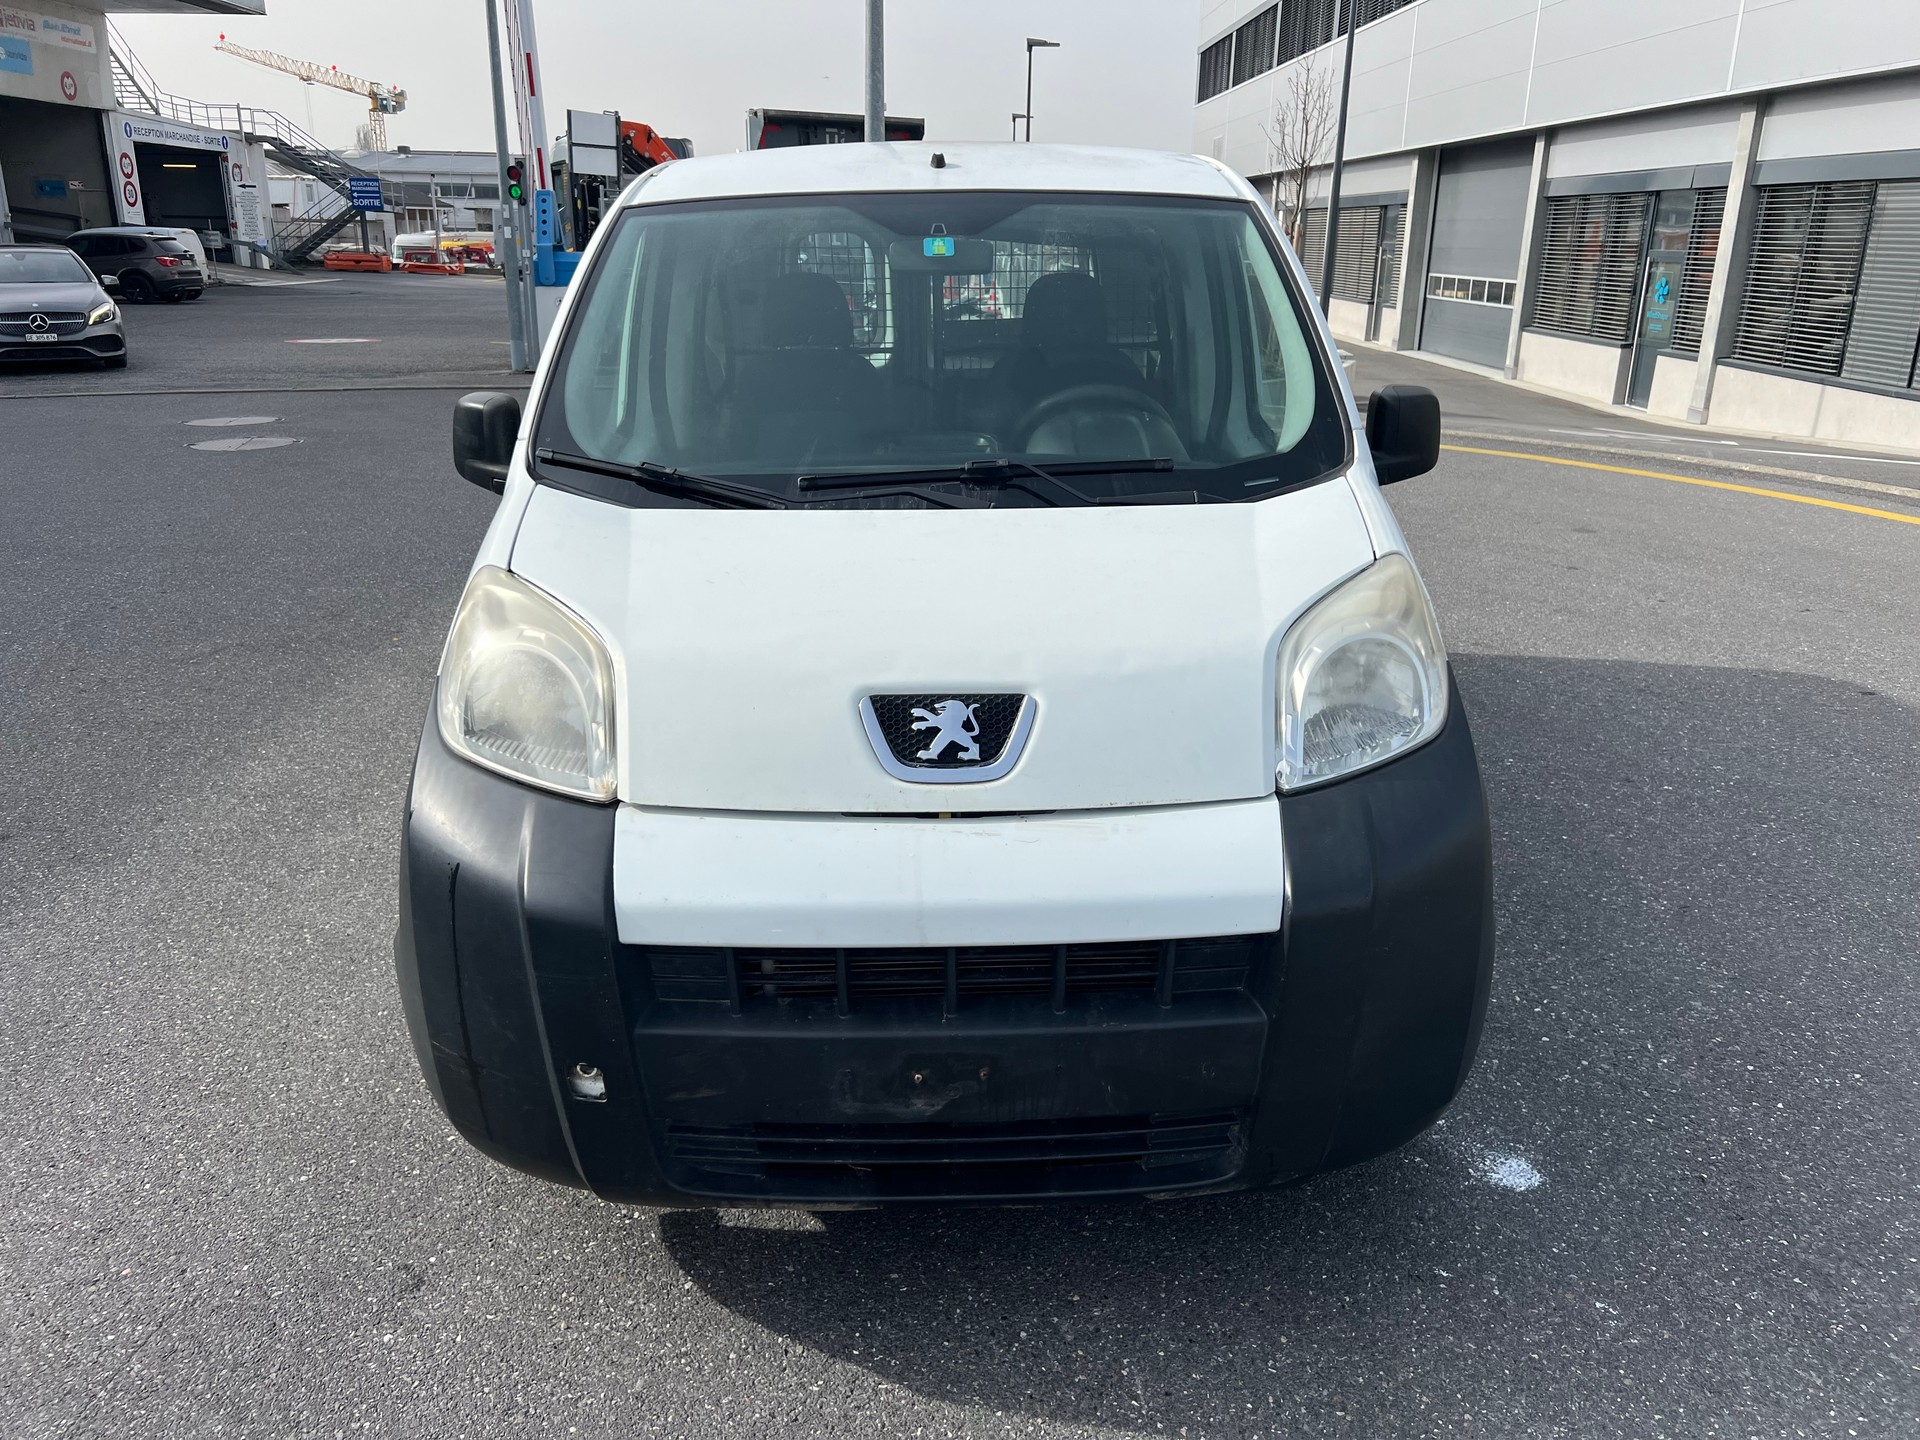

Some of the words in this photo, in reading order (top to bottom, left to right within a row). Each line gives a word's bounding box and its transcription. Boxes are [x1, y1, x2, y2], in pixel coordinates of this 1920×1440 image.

[133, 126, 164, 138] RECEPTION
[165, 130, 201, 143] MARCHANDISE
[204, 136, 222, 146] SORTIE
[127, 189, 135, 199] 30
